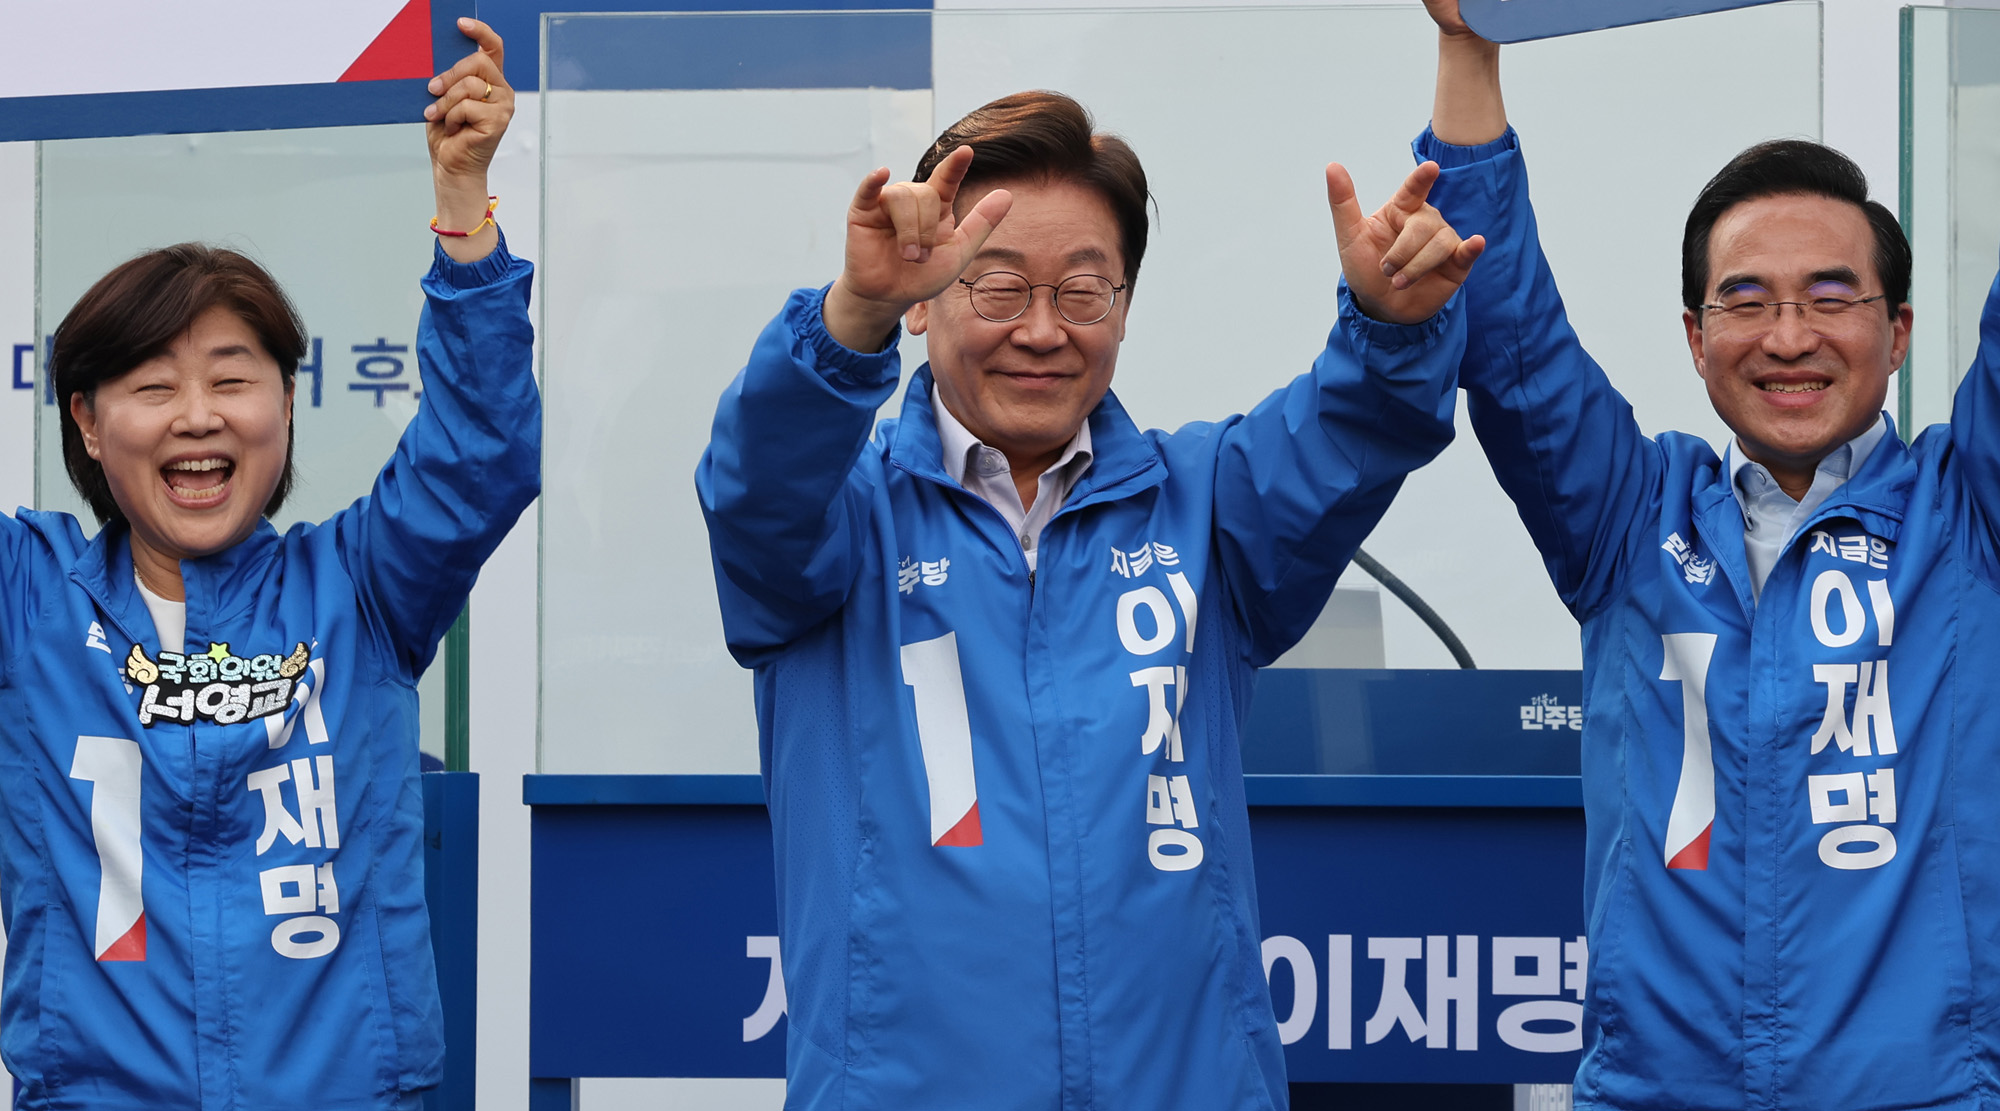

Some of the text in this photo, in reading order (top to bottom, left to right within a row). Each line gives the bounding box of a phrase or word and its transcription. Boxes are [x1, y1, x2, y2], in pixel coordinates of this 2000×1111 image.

[1110, 541, 1180, 579] 지금은
[1809, 530, 1889, 570] 지금은
[898, 557, 950, 595] 주당
[158, 652, 282, 685] 국회의원
[138, 678, 292, 725] 서영교
[1531, 693, 1558, 706] 더불어
[1808, 569, 1898, 870] 이재명
[900, 630, 984, 847] 1
[1659, 632, 1716, 871] 1
[69, 735, 147, 962] 1
[1261, 933, 1589, 1053] 이재명
